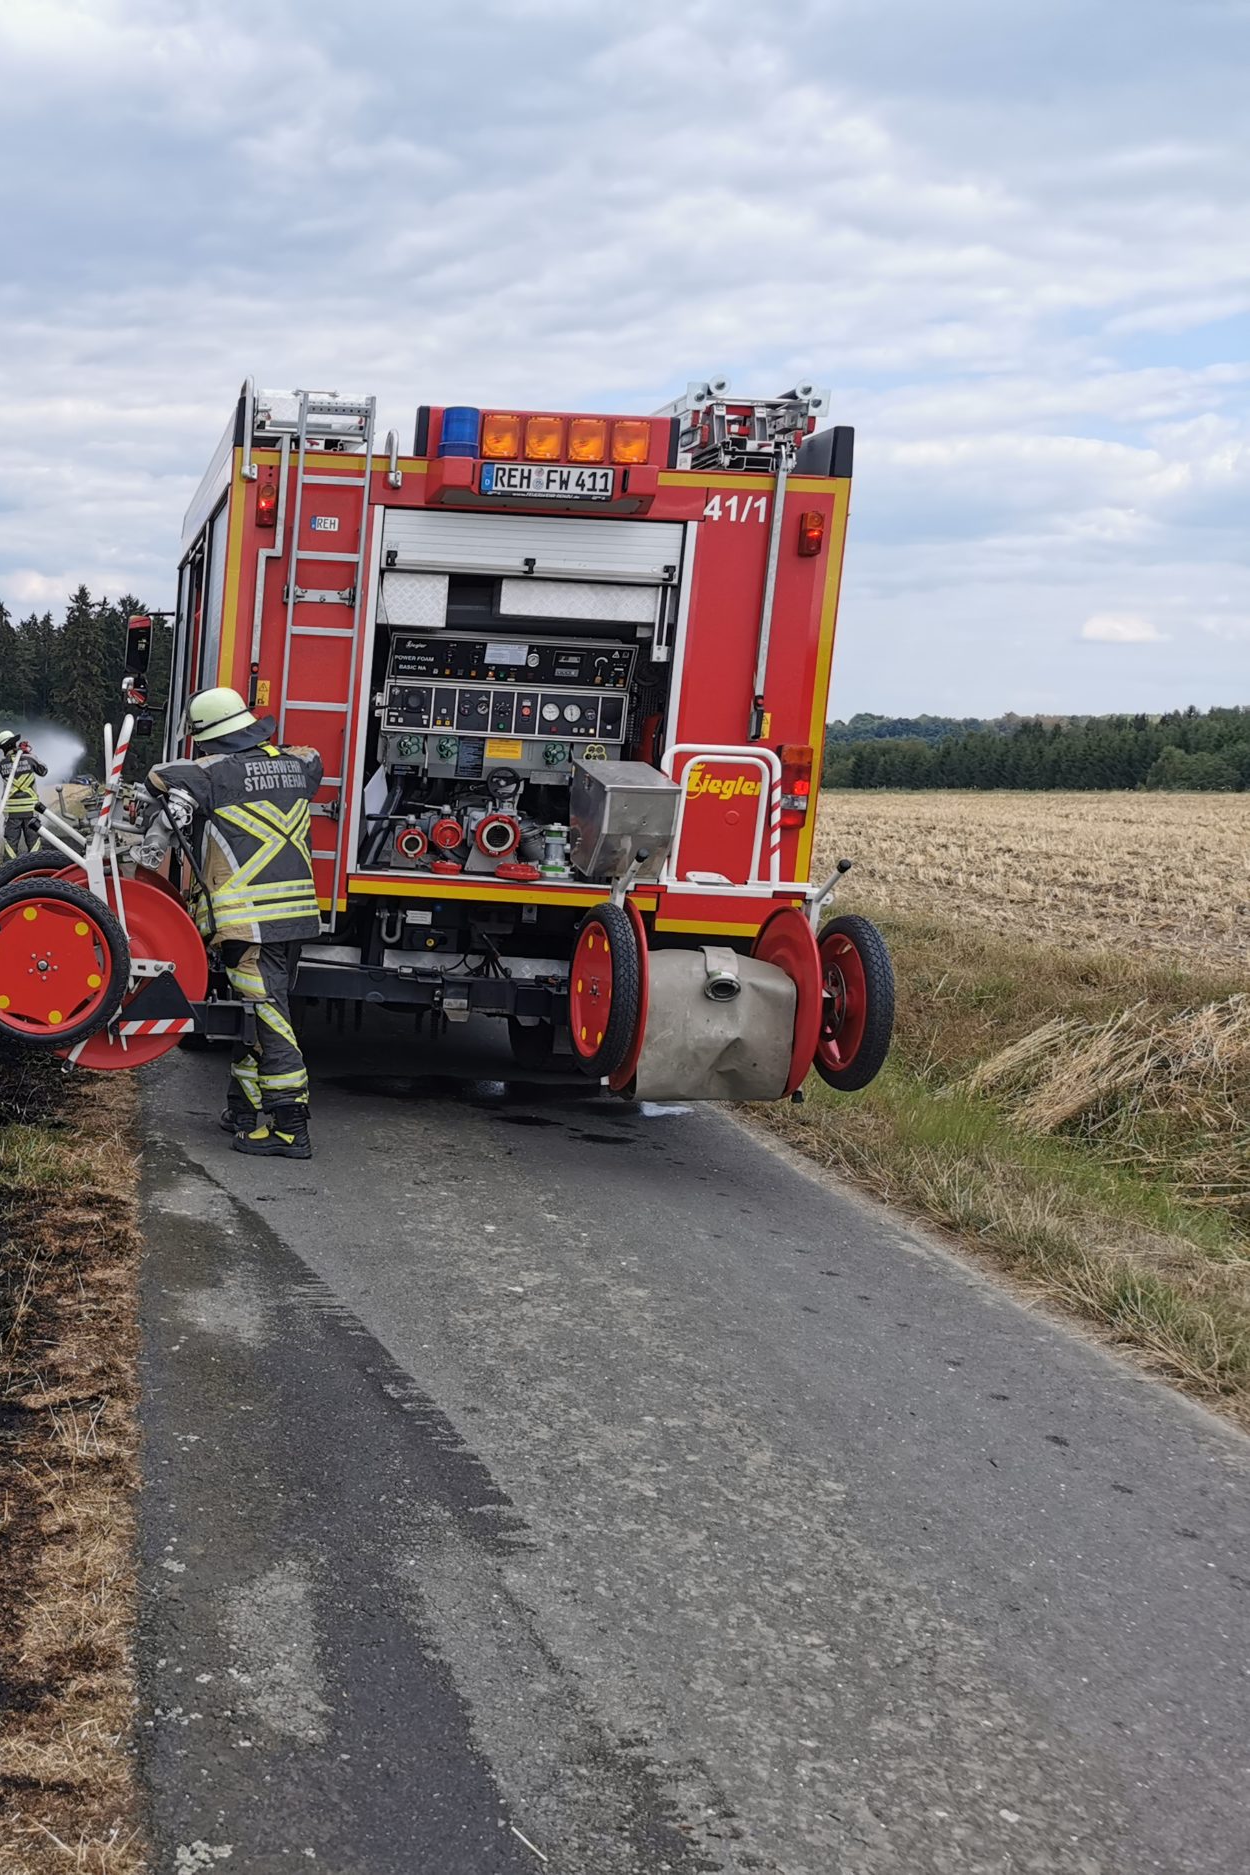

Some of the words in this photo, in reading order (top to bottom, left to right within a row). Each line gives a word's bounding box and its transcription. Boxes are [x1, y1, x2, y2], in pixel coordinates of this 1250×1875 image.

[495, 467, 531, 489] REH
[546, 469, 571, 491] FW
[575, 471, 610, 493] 411
[703, 494, 767, 523] 41/1
[316, 517, 336, 530] REH
[395, 654, 416, 662] POWER
[244, 760, 303, 777] FEUERWEHR
[244, 774, 280, 792] STADT
